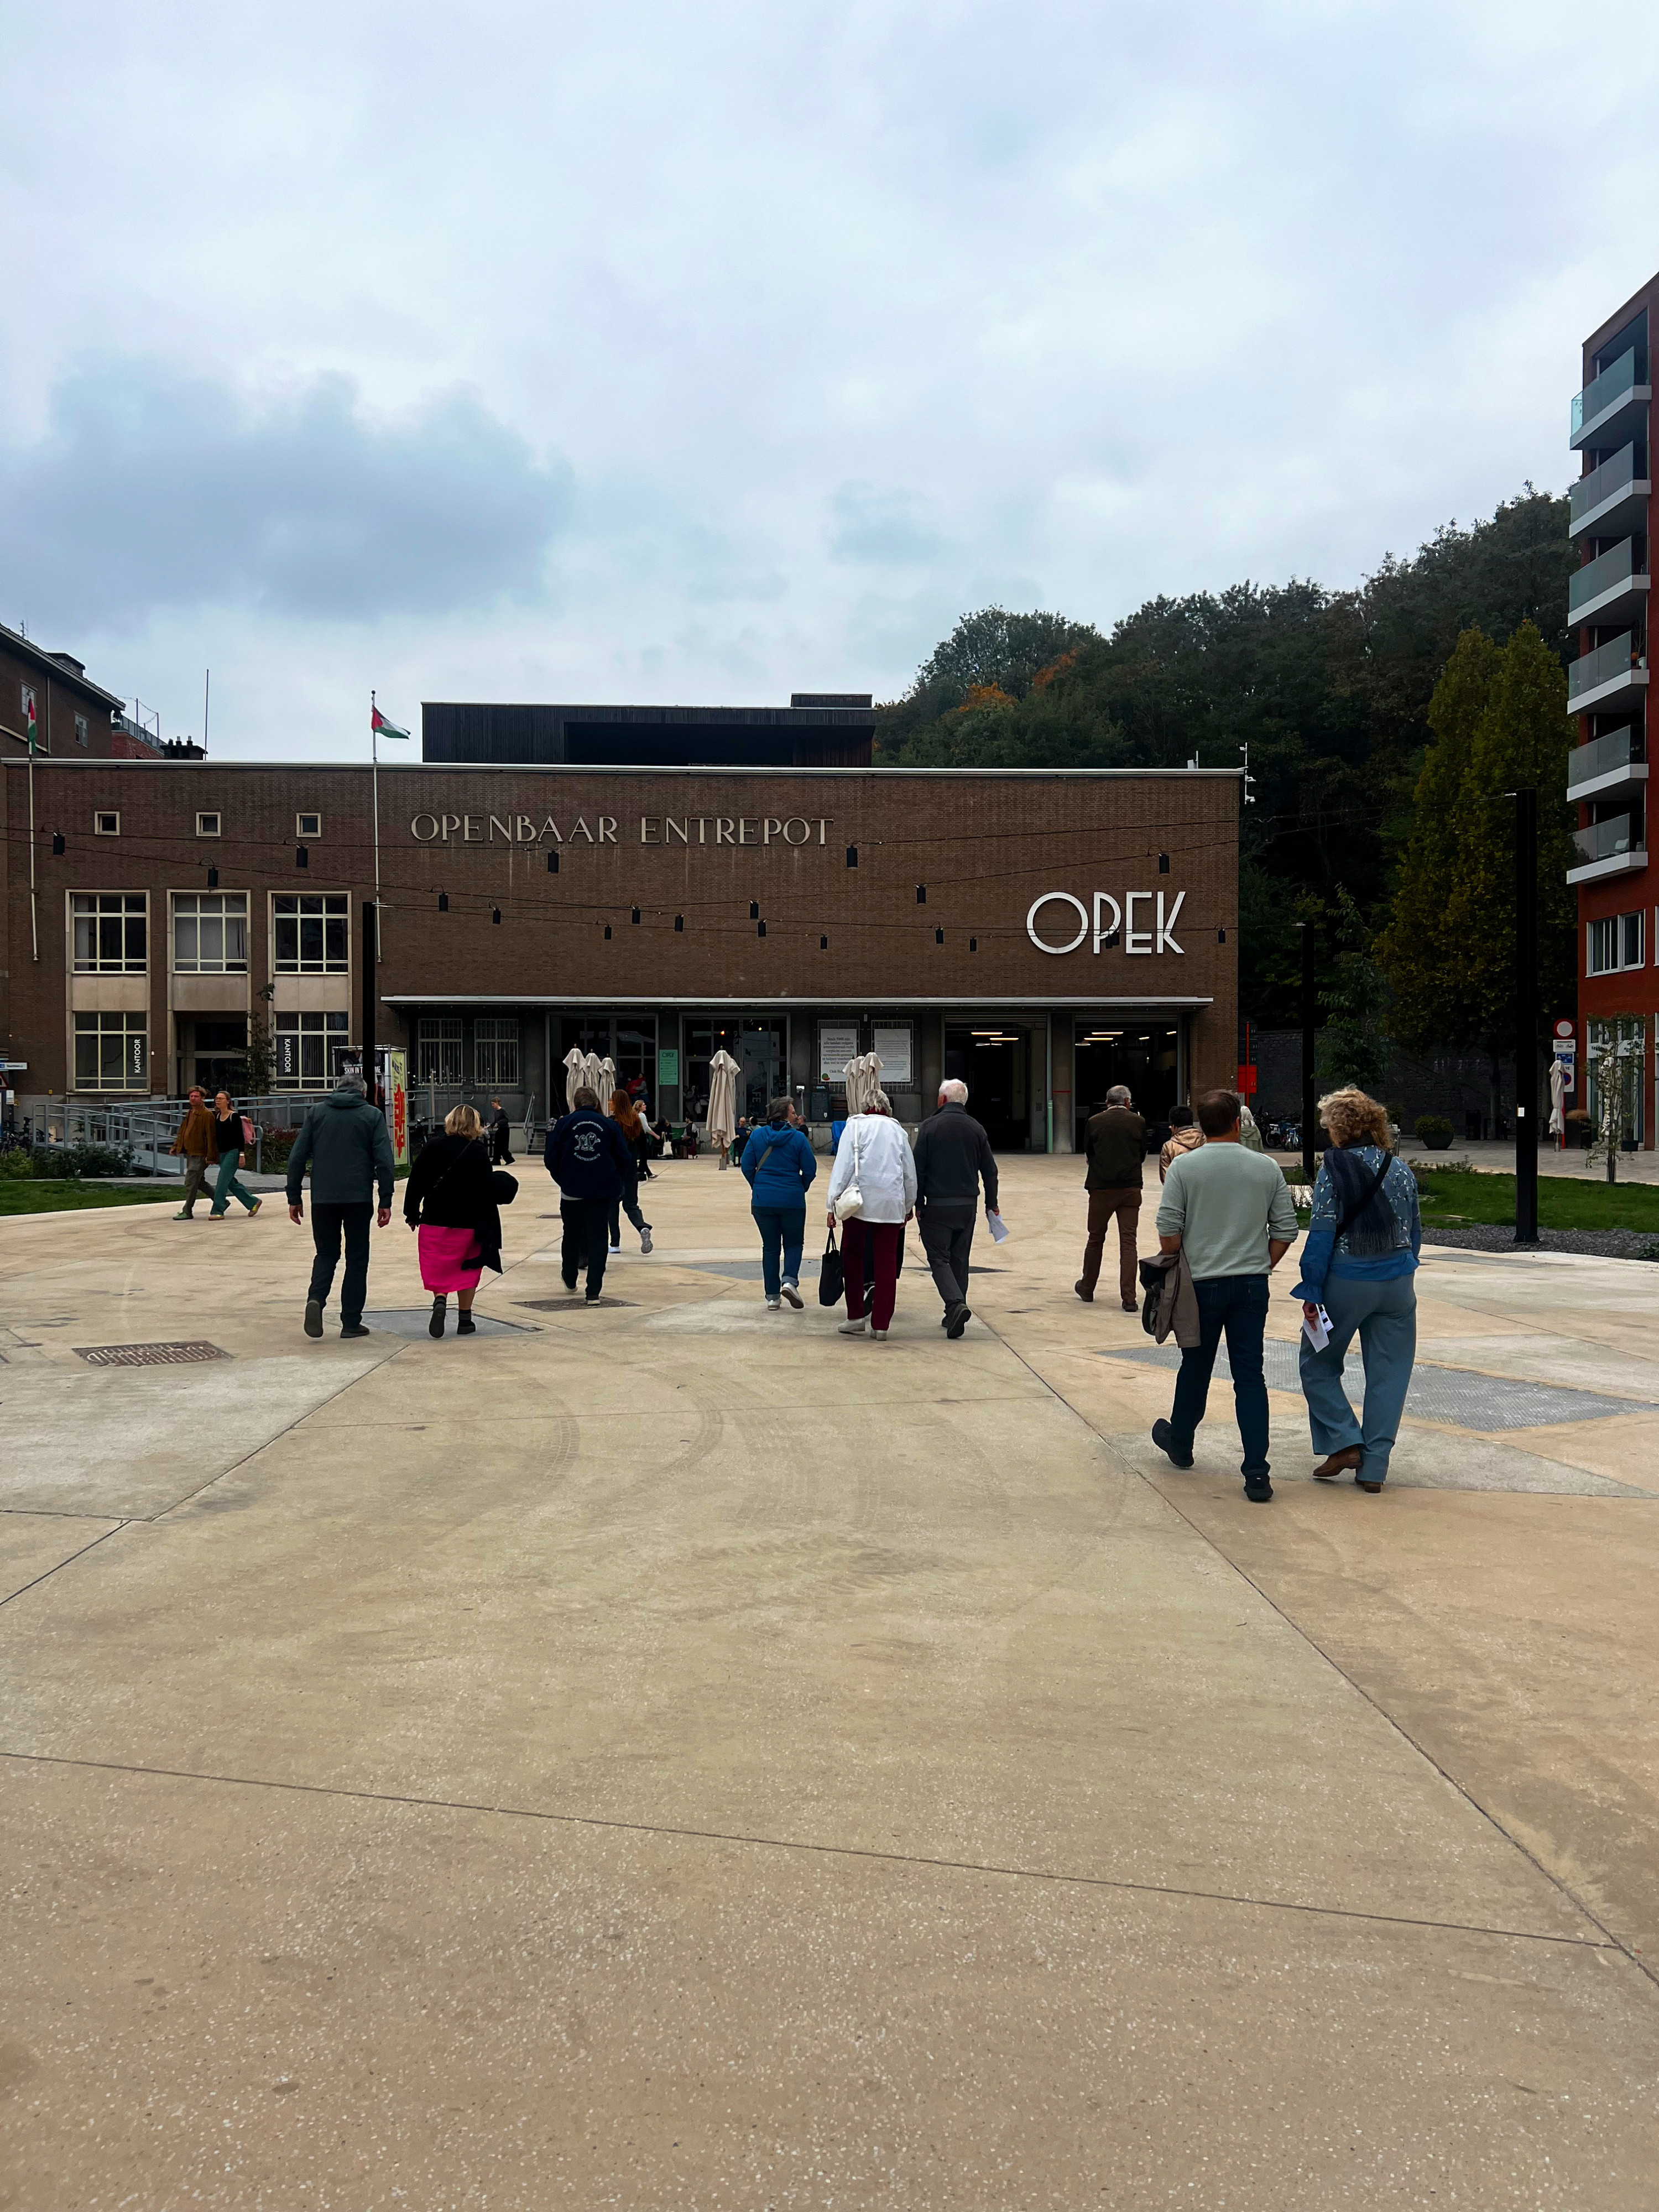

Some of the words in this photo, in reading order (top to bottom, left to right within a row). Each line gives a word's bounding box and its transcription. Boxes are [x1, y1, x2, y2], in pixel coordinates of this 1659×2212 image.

[411, 813, 618, 843] OPENBAAR
[641, 817, 834, 844] ENTREPOT
[1026, 891, 1186, 954] OPEK
